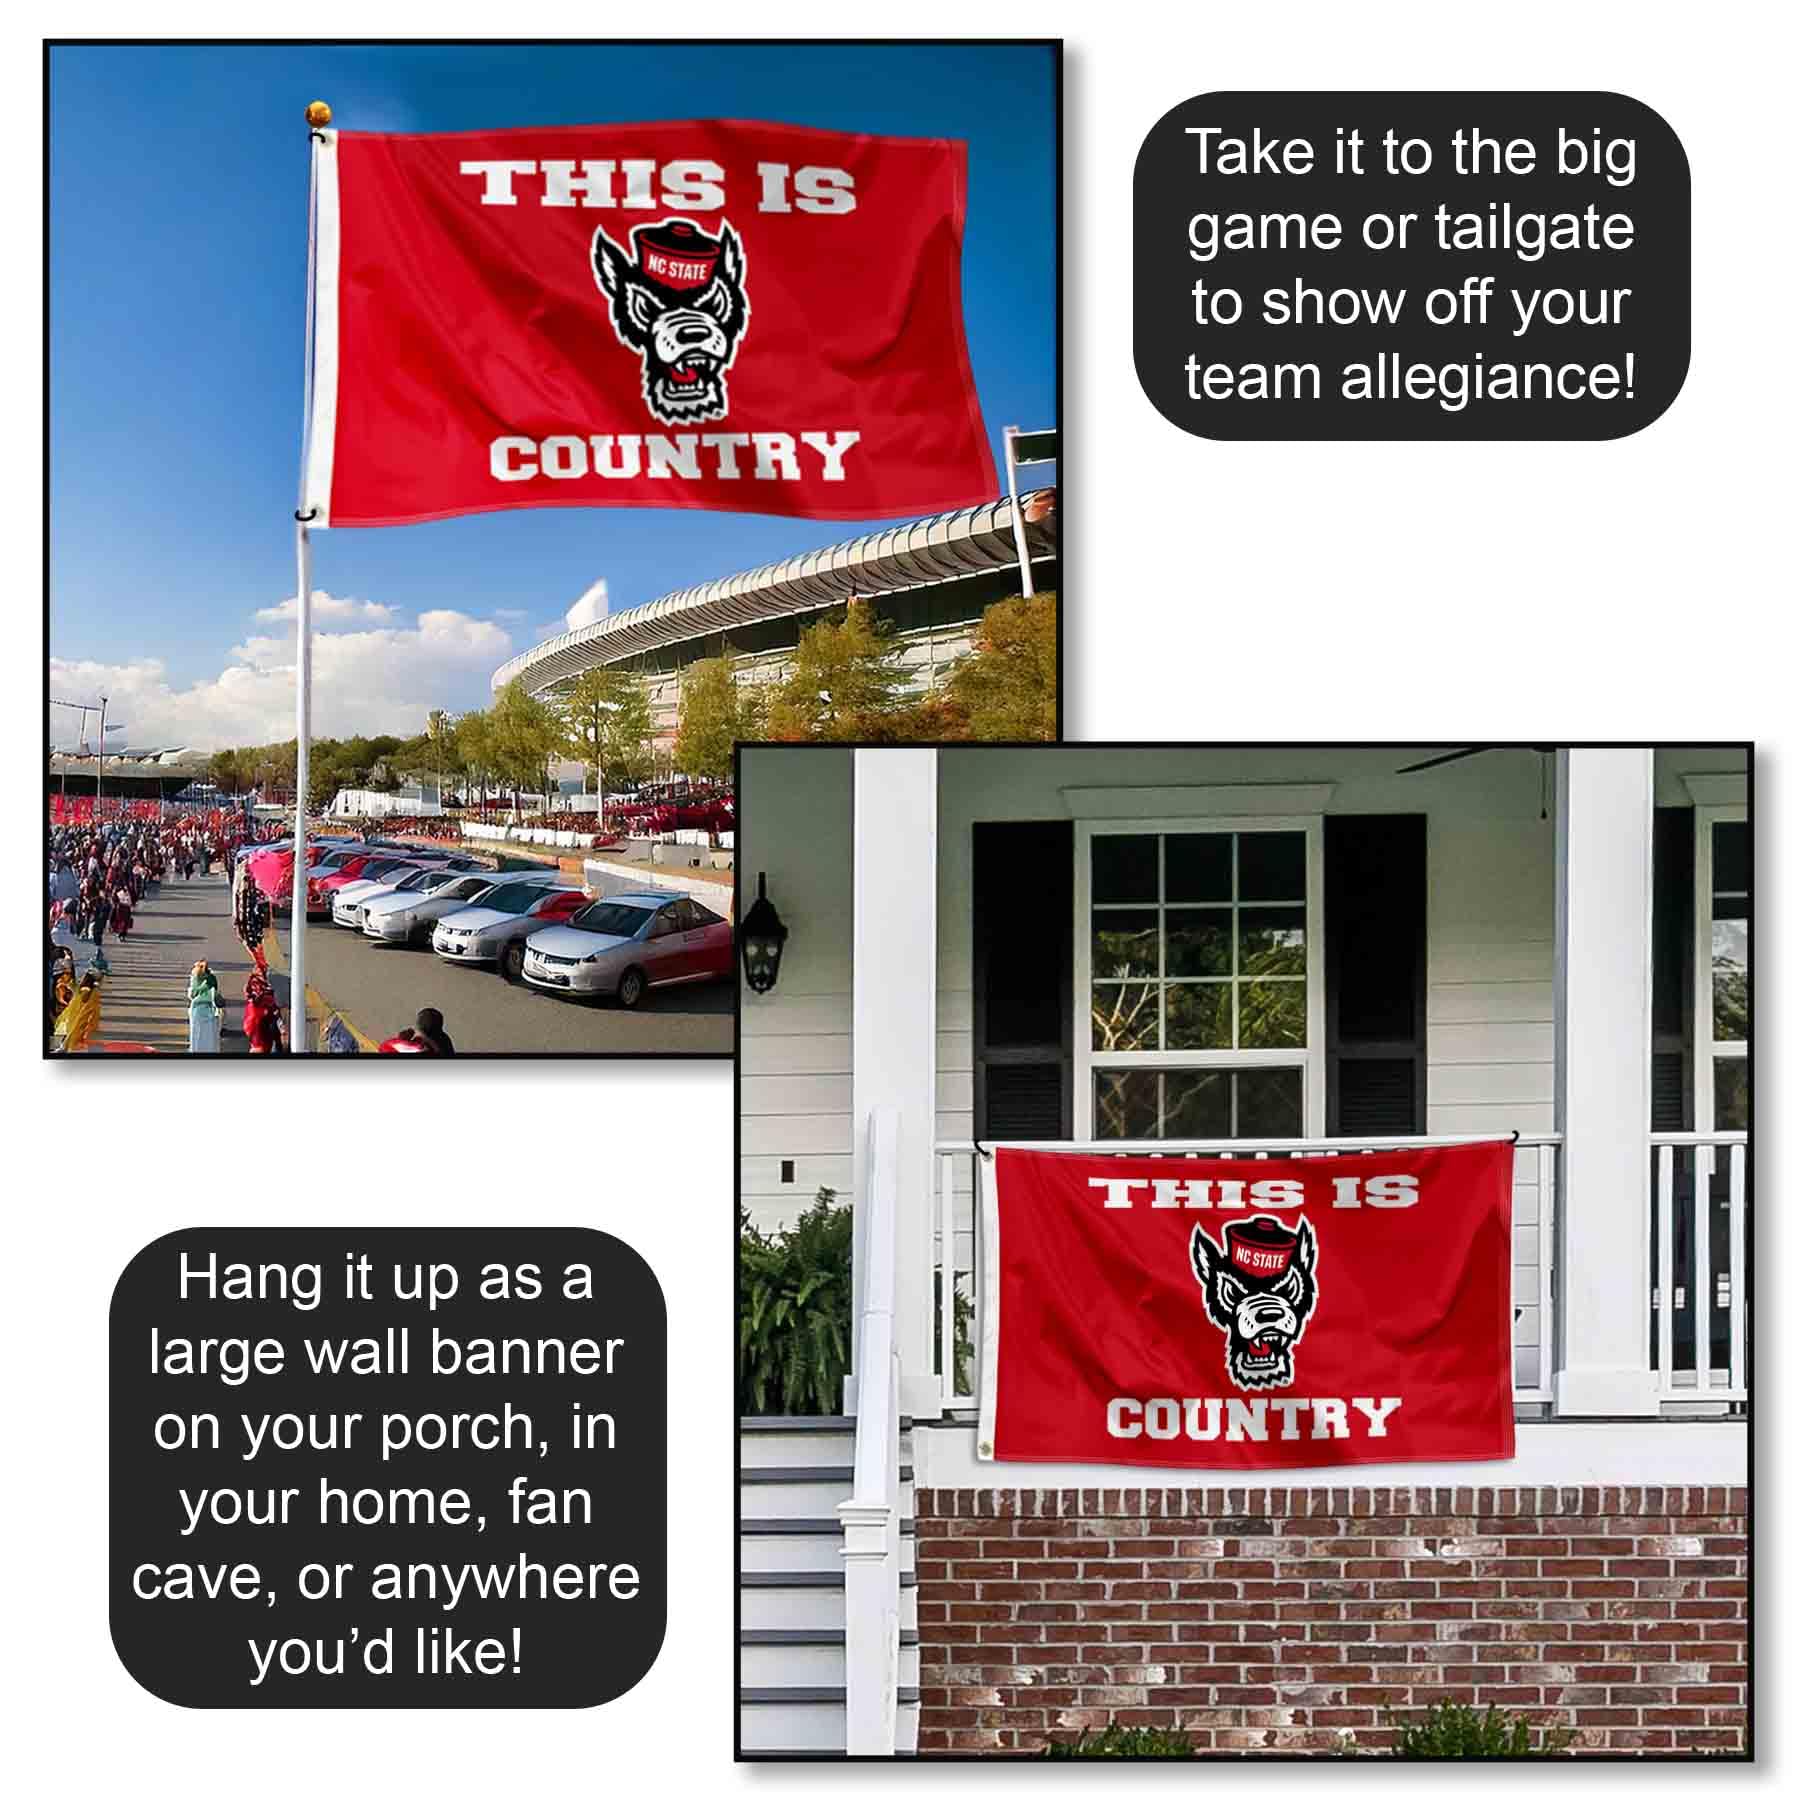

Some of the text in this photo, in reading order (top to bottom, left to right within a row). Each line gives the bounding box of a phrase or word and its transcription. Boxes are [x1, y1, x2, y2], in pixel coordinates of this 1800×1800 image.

[460, 160, 856, 214] THIS IS
[648, 254, 707, 280] NC STATE
[490, 432, 860, 481] COUNTRY
[1088, 1175, 1418, 1208] THIS IS
[1236, 1246, 1284, 1268] NC STATE
[1107, 1398, 1401, 1441] COUNTRY
